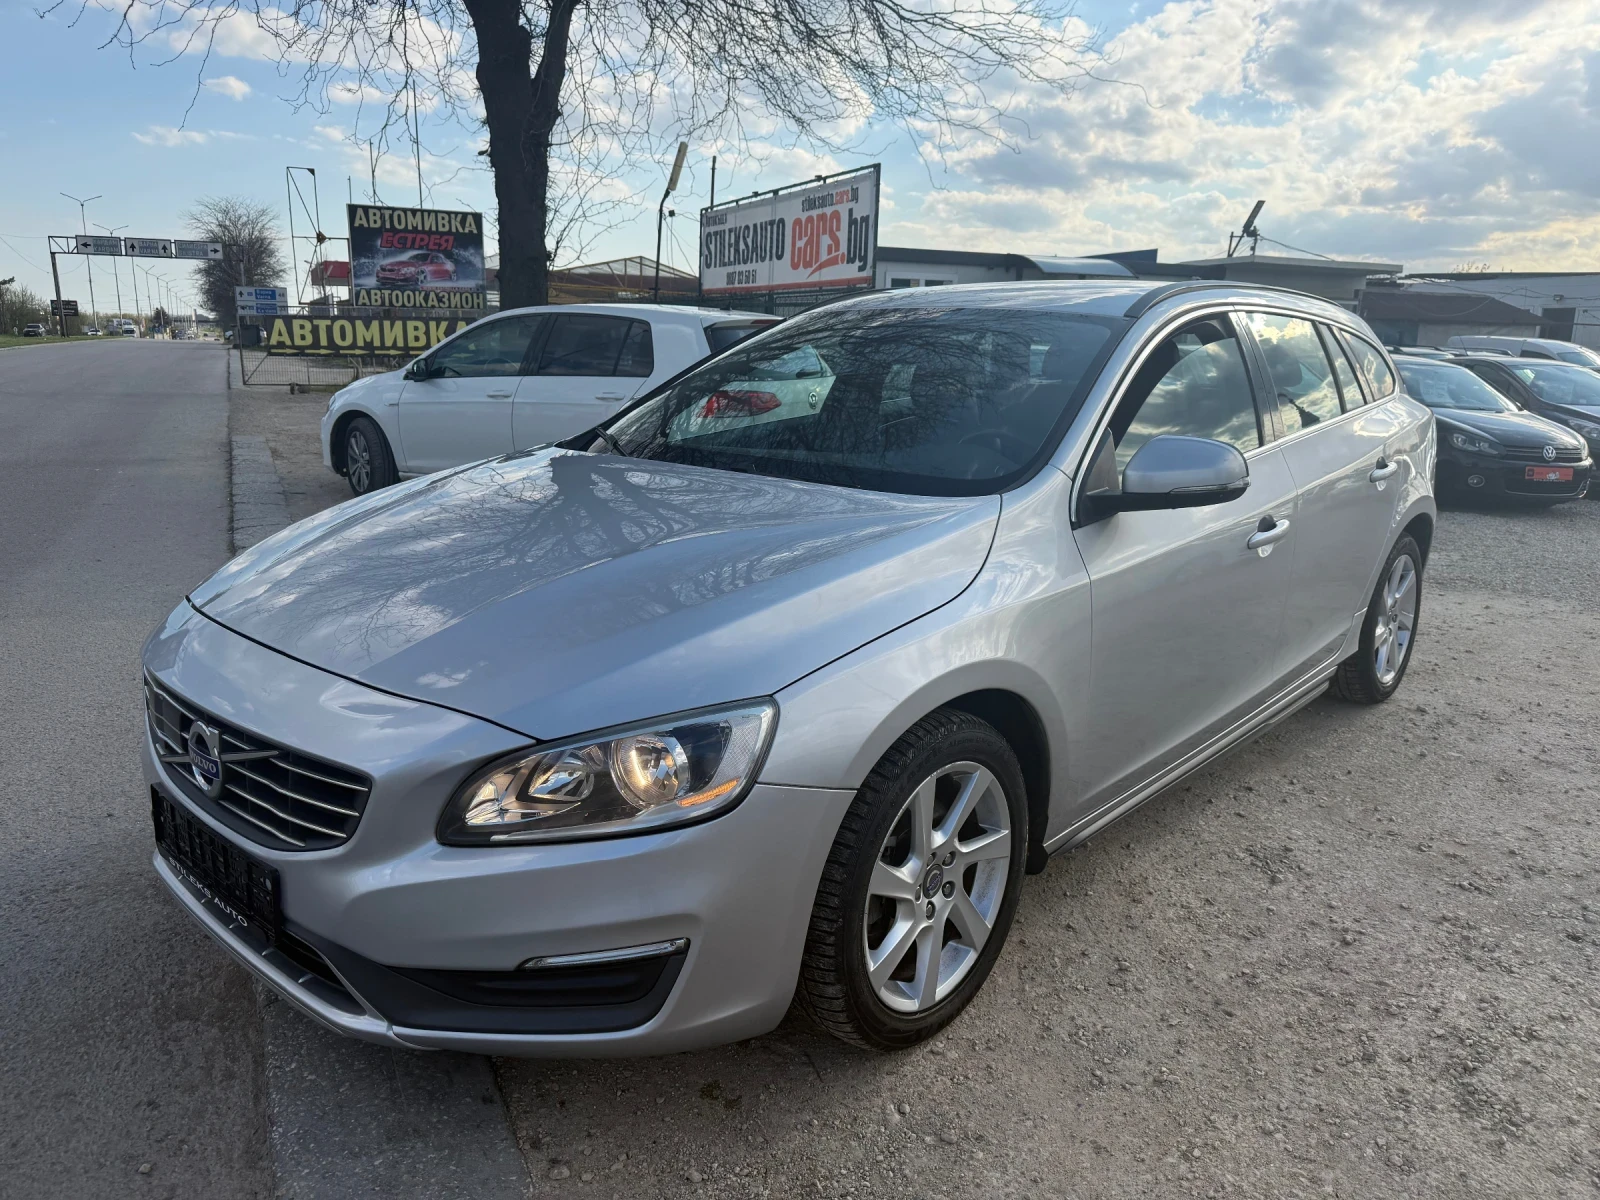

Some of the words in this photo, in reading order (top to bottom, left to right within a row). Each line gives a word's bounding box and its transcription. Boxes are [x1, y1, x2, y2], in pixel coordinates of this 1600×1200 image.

[354, 207, 478, 234] АВТОМИВКА
[380, 232, 454, 251] ЕСТРЕЯ
[705, 217, 786, 269] STILEKSAUTO
[790, 207, 870, 273] cars.bg
[357, 288, 484, 309] АВТООКАЗИОН
[190, 750, 217, 773] VOLVO
[169, 857, 212, 898] STILEKS
[214, 897, 248, 927] AUTO
